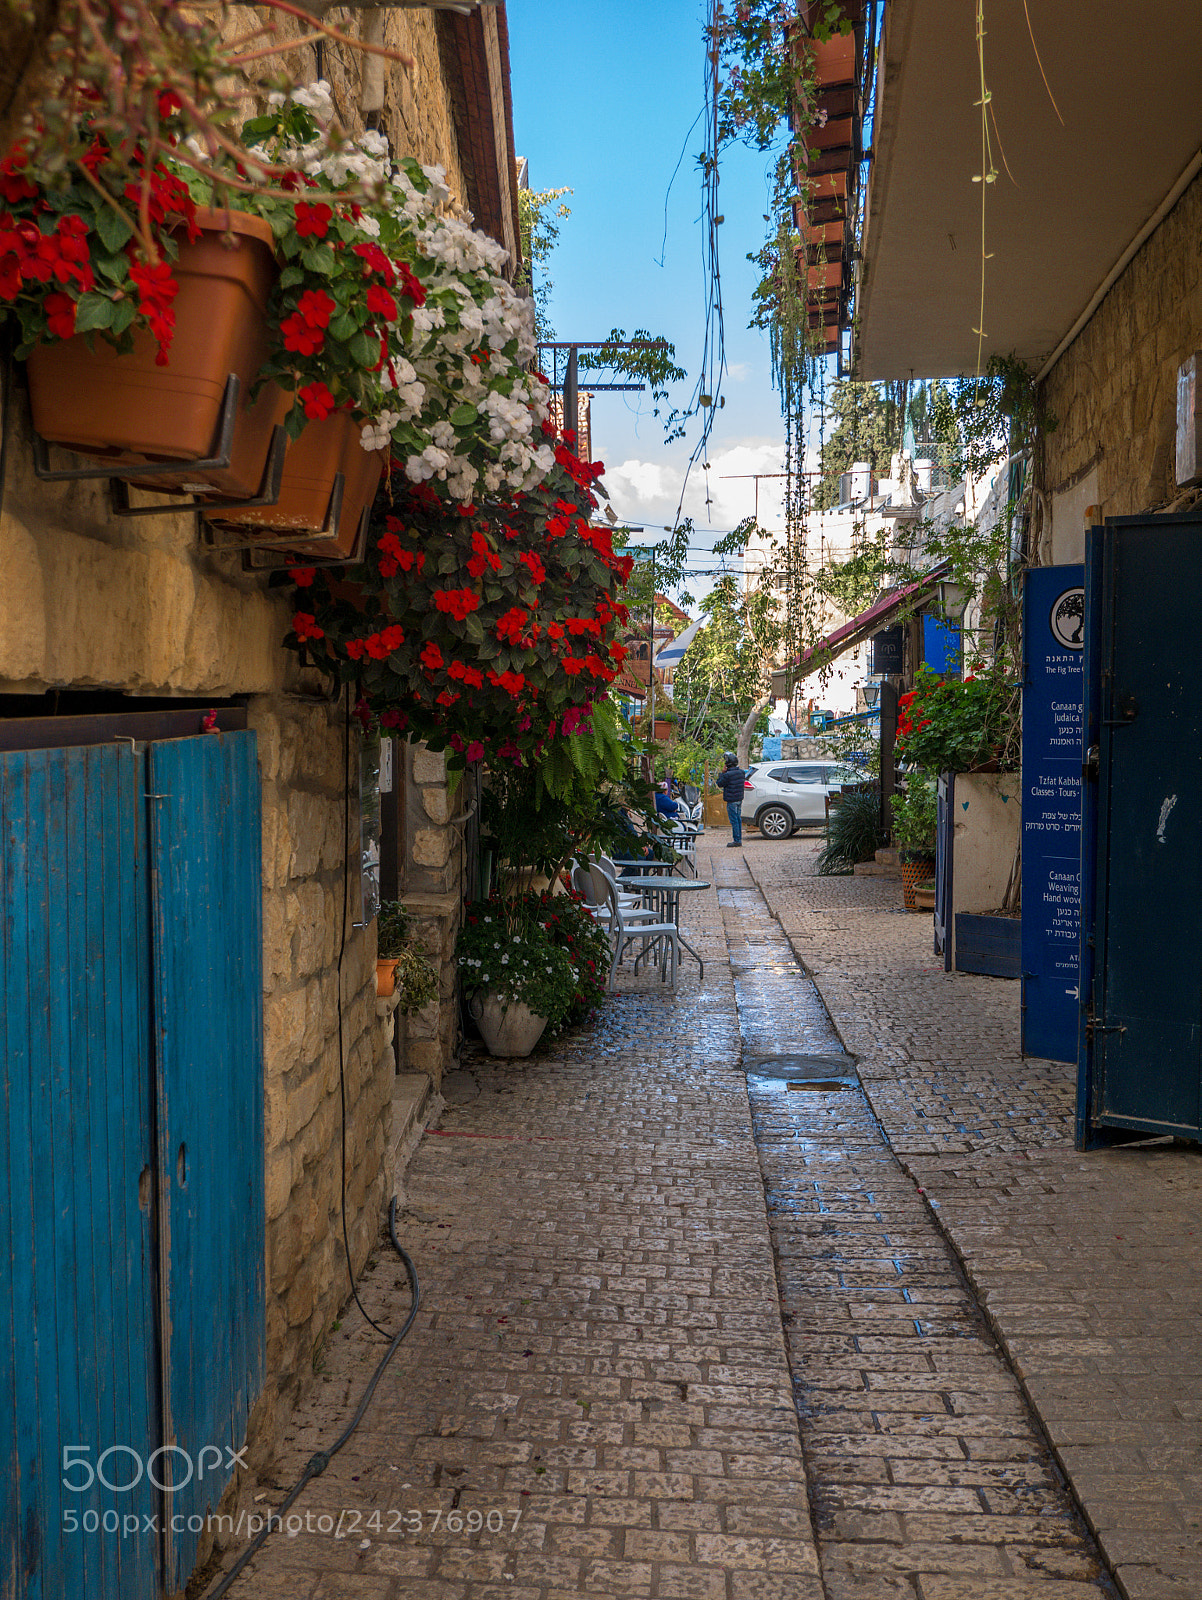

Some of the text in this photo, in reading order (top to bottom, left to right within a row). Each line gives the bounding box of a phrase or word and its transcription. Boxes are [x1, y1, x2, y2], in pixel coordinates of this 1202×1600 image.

[1045, 655, 1074, 663] התאנה
[1045, 666, 1057, 674] The
[1057, 666, 1067, 675] Fig
[1067, 665, 1081, 673] Tree
[1051, 701, 1077, 711] Canaan
[1054, 712, 1080, 724] Judaica
[1058, 727, 1074, 736] כנען
[1049, 738, 1075, 746] ואמנות
[1038, 775, 1082, 786] Tzfat Kabbal
[1031, 786, 1077, 797] Classes Tours
[1041, 812, 1057, 820] צפת
[1057, 811, 1068, 820] של
[1049, 870, 1075, 881] Canaan
[1048, 881, 1079, 896] Weaving
[1043, 892, 1062, 903] Hand
[1056, 908, 1072, 917] כנען
